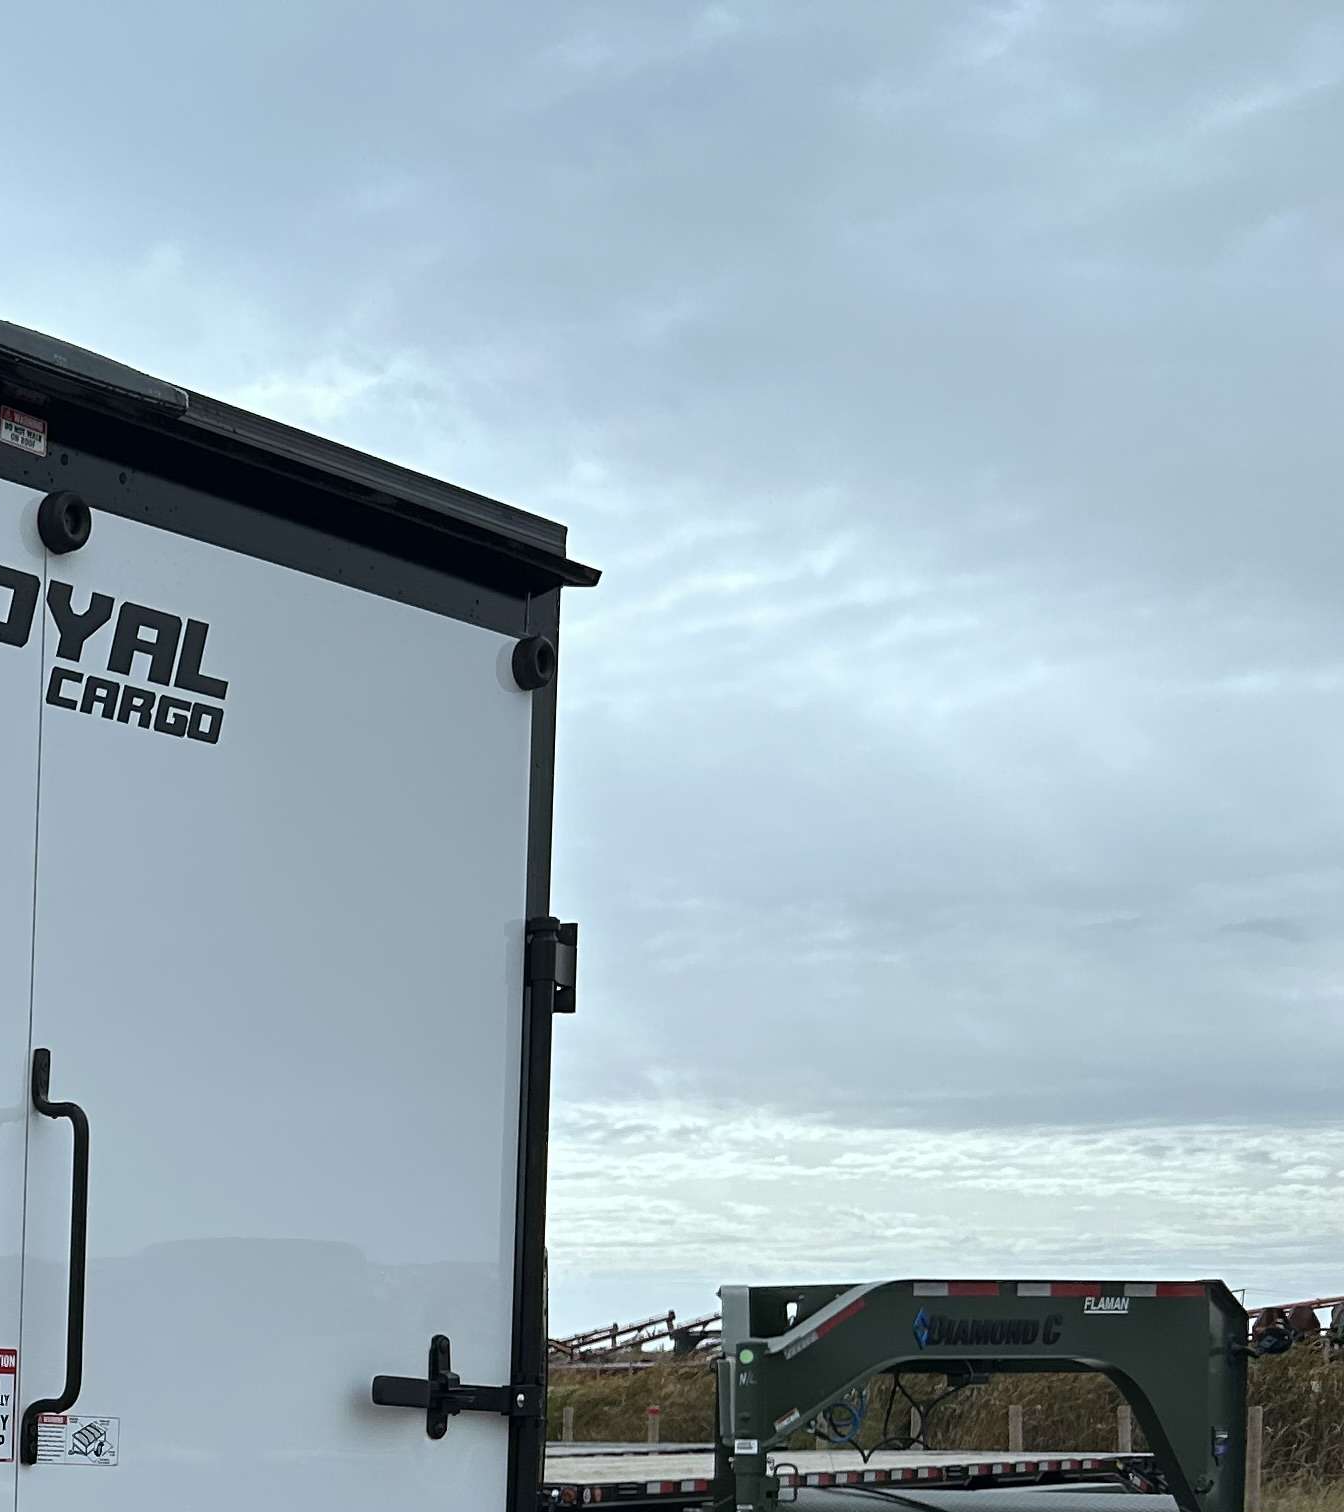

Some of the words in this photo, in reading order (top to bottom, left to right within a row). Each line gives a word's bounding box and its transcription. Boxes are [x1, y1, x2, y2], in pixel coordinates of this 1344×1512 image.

[46, 666, 224, 745] CARGO
[1084, 1297, 1130, 1310] FLAMAN
[927, 1315, 1040, 1346] DIAMOND
[1042, 1313, 1063, 1346] C
